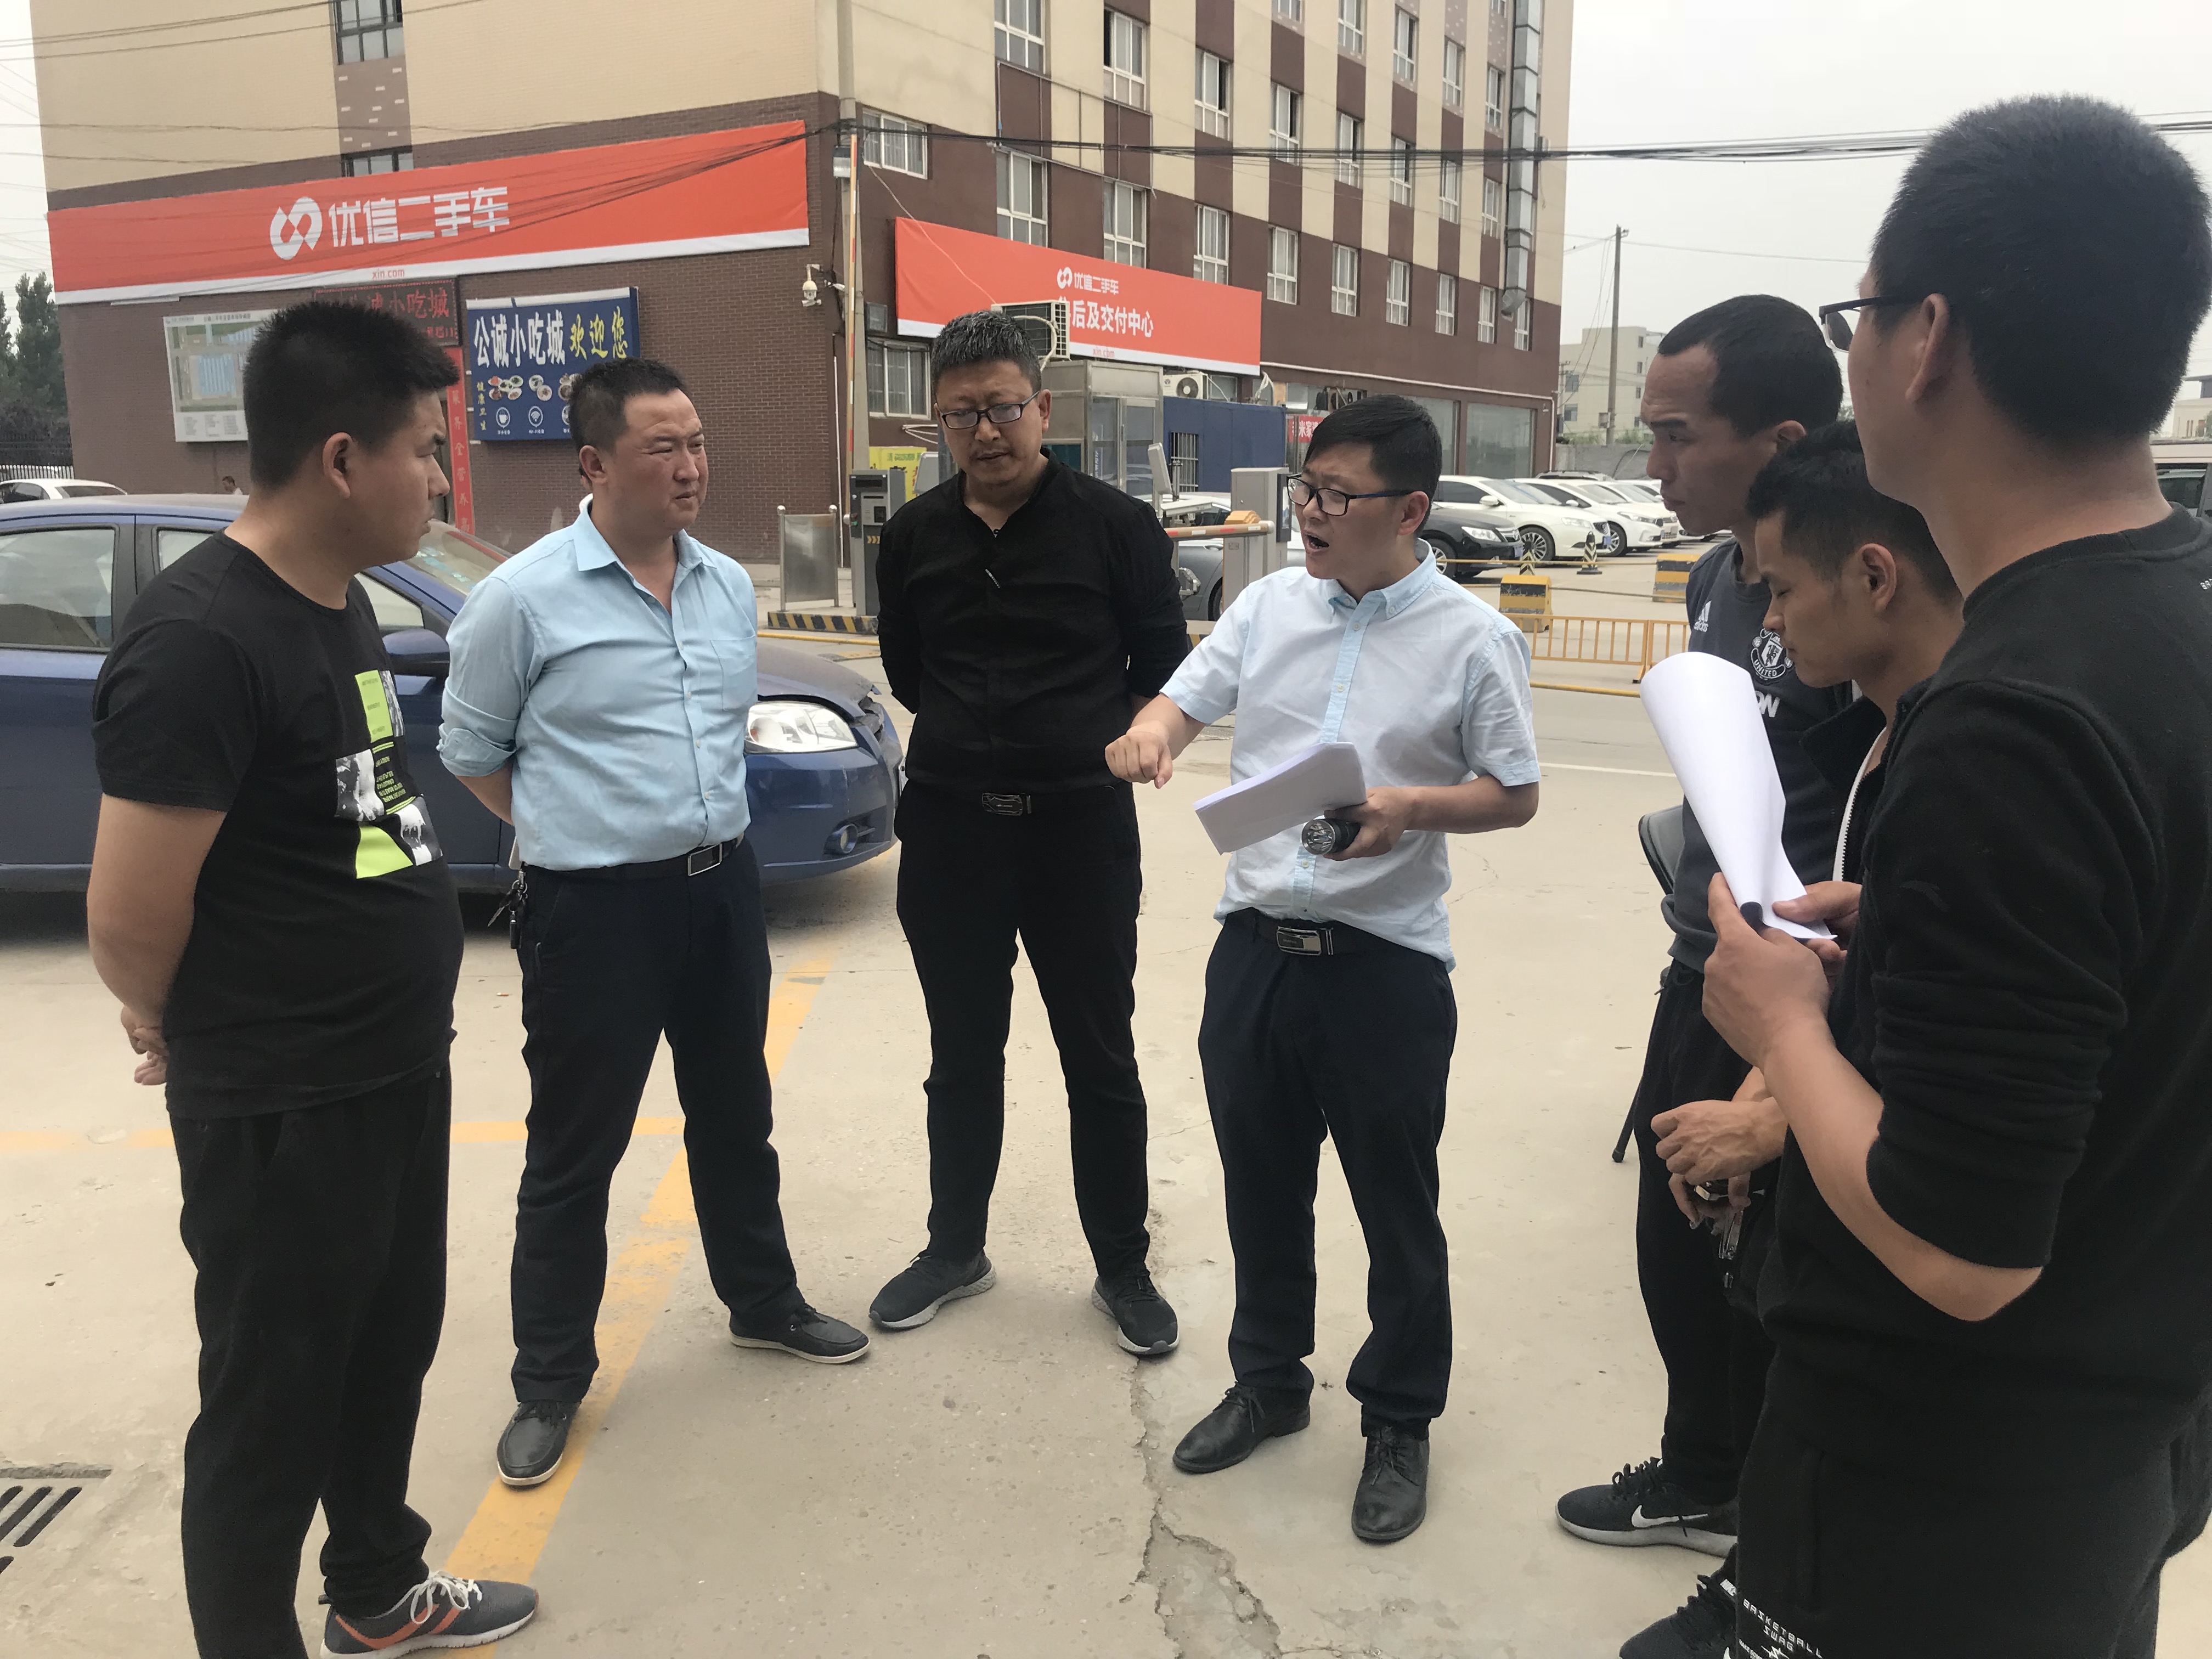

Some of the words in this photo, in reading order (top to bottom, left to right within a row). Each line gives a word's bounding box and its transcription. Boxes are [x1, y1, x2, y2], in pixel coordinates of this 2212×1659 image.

[329, 187, 510, 247] 优信二手车
[372, 268, 405, 280] xin.com
[1074, 272, 1119, 295] 优信二手车
[1058, 296, 1154, 338] 后及交付中心
[1092, 347, 1115, 358] xin.com
[1754, 659, 1778, 677] UNITED
[1742, 1598, 1823, 1659] BASKETBALL
[1763, 1625, 1794, 1652] SWAG
